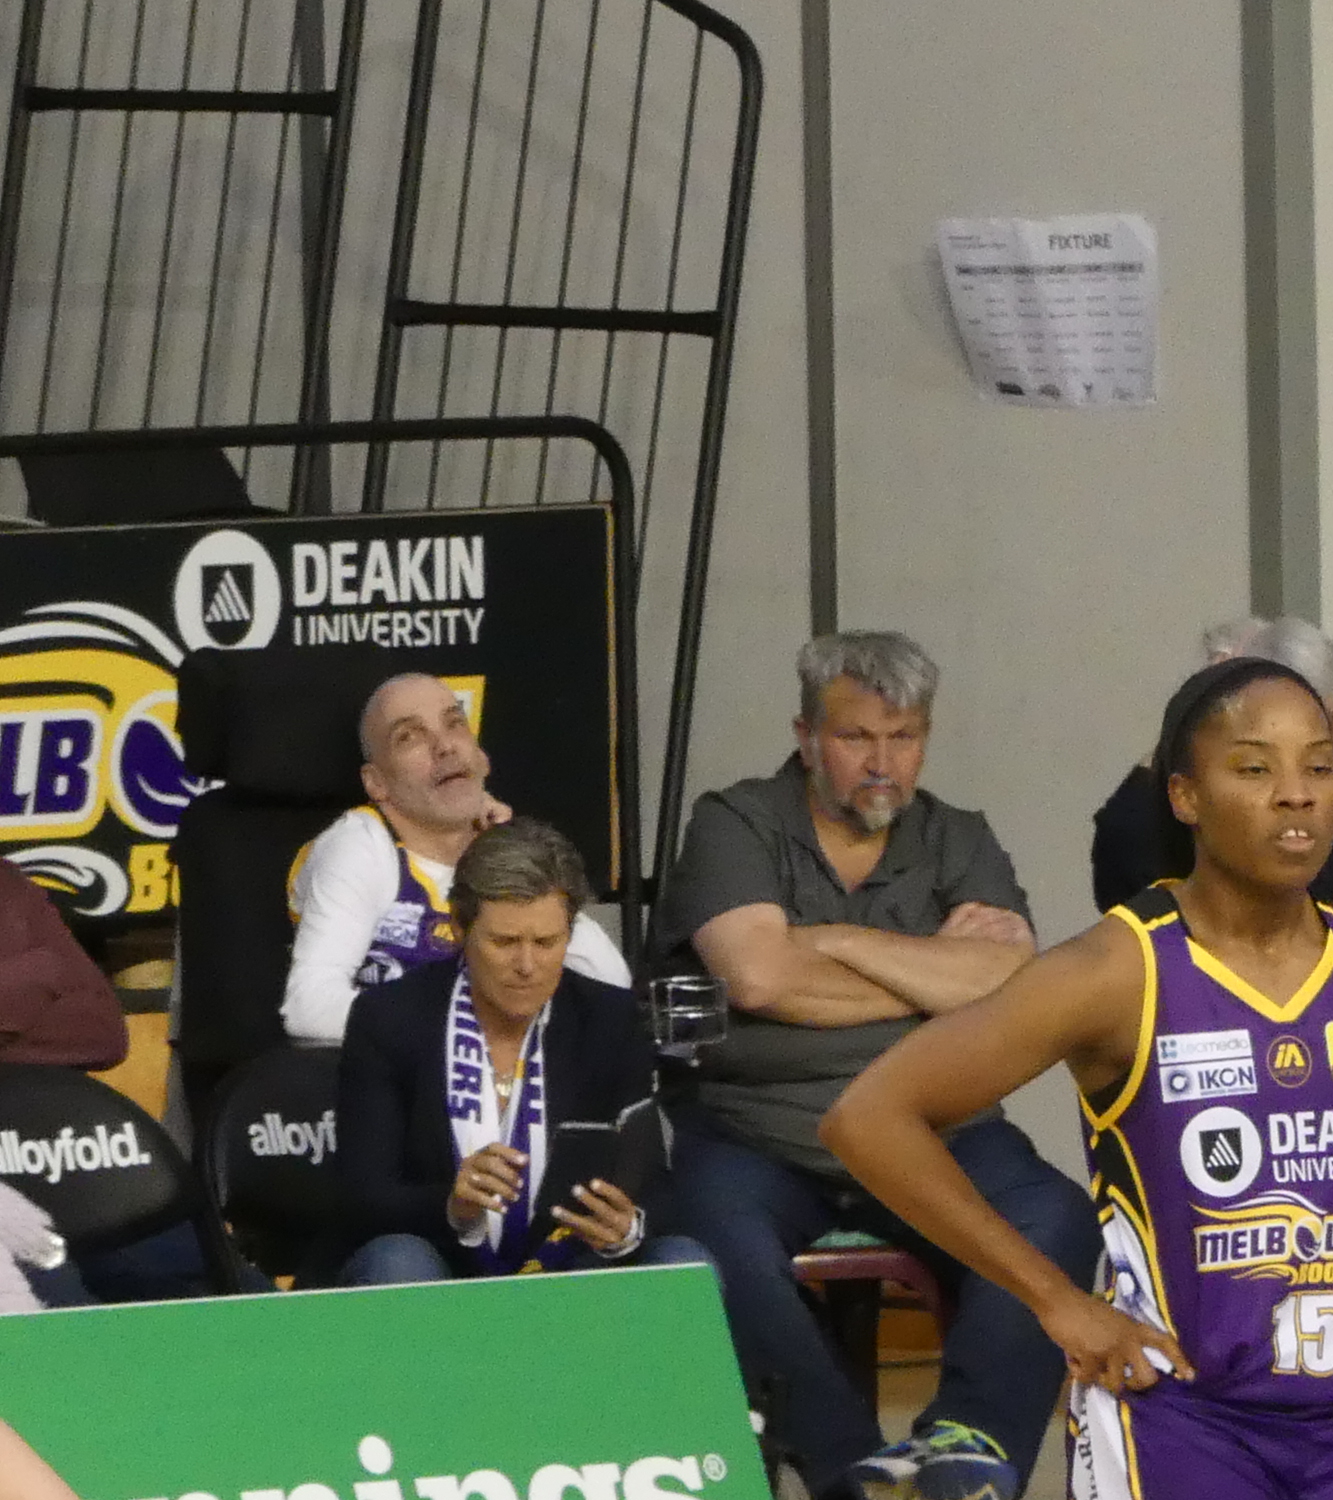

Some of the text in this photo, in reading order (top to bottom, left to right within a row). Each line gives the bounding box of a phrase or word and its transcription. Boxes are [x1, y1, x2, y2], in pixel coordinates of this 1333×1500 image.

[1048, 232, 1114, 250] FIXTURE
[294, 535, 485, 608] DEAKIN
[294, 607, 486, 648] UNIVERSITY
[1197, 1066, 1254, 1090] IKON
